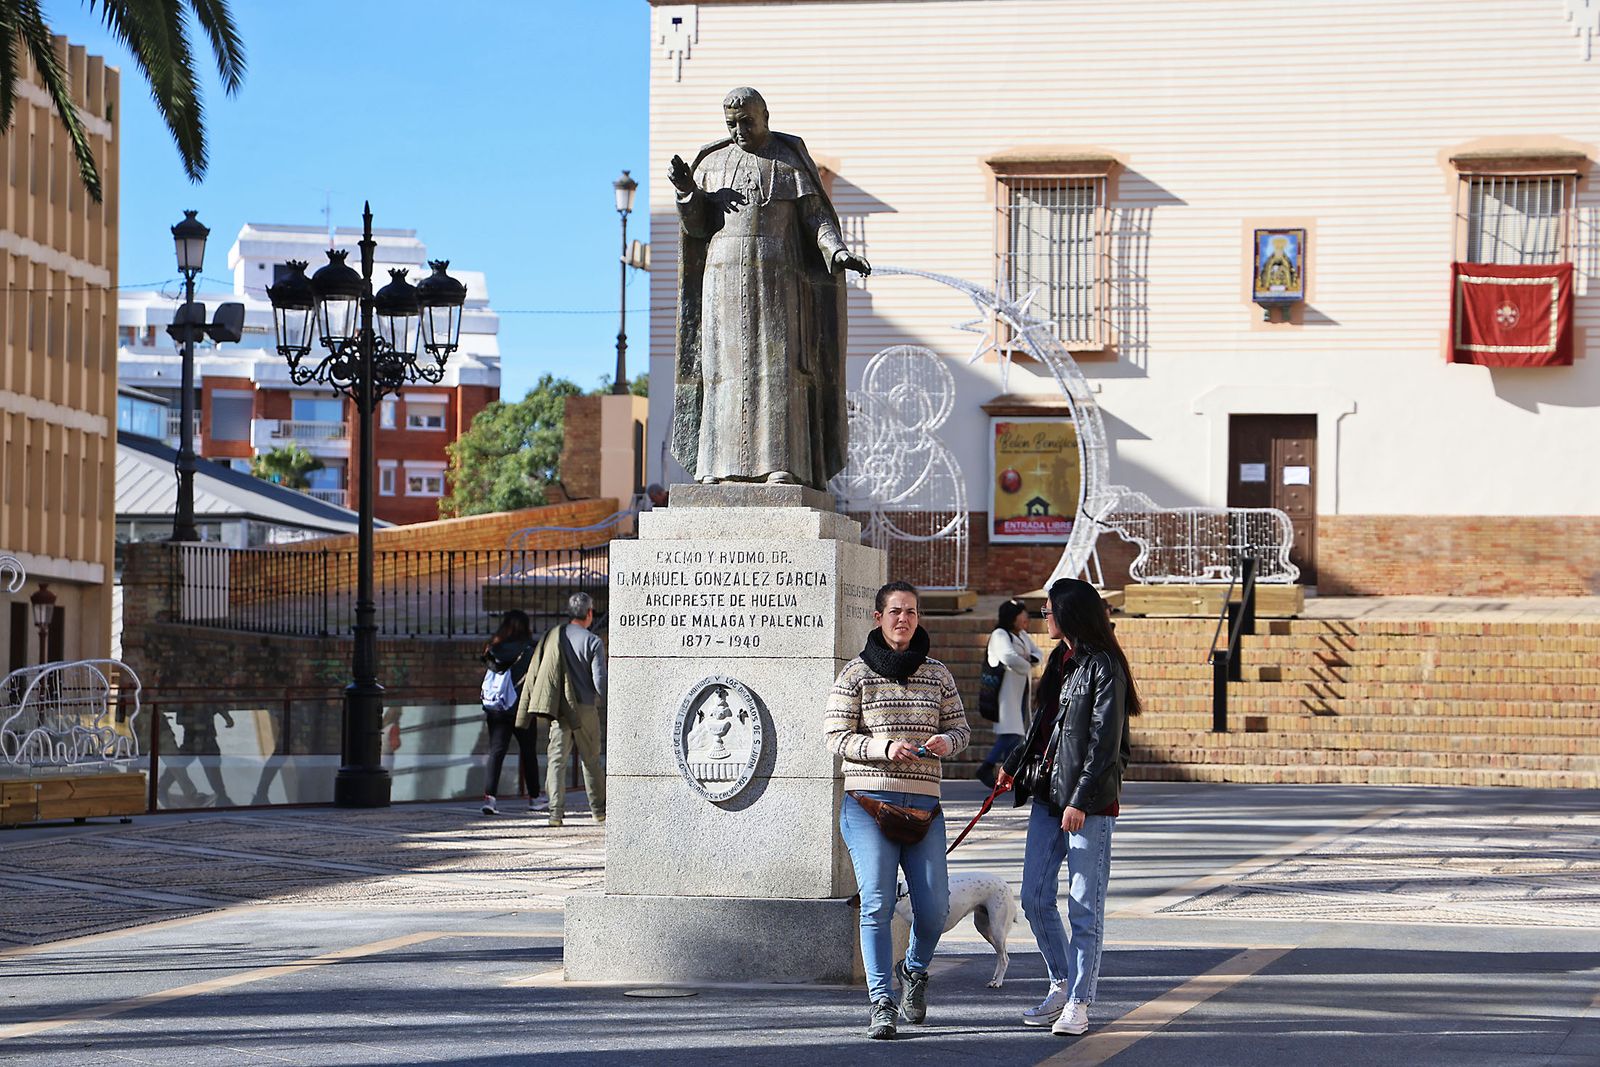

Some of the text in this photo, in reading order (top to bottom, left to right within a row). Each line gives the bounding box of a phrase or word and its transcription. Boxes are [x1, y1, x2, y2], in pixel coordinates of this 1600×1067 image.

[1004, 521, 1073, 529] ENTRADA LIBRE
[708, 551, 714, 564] Y
[694, 571, 770, 586] GONZALEZ
[776, 571, 827, 586] GARCIA
[646, 594, 797, 607] ARCIPRESTE DE HUELVA
[620, 614, 824, 628] OBISPO DE MALAGA Y PALENCIA
[682, 634, 712, 647] 1877
[729, 634, 760, 648] 1940
